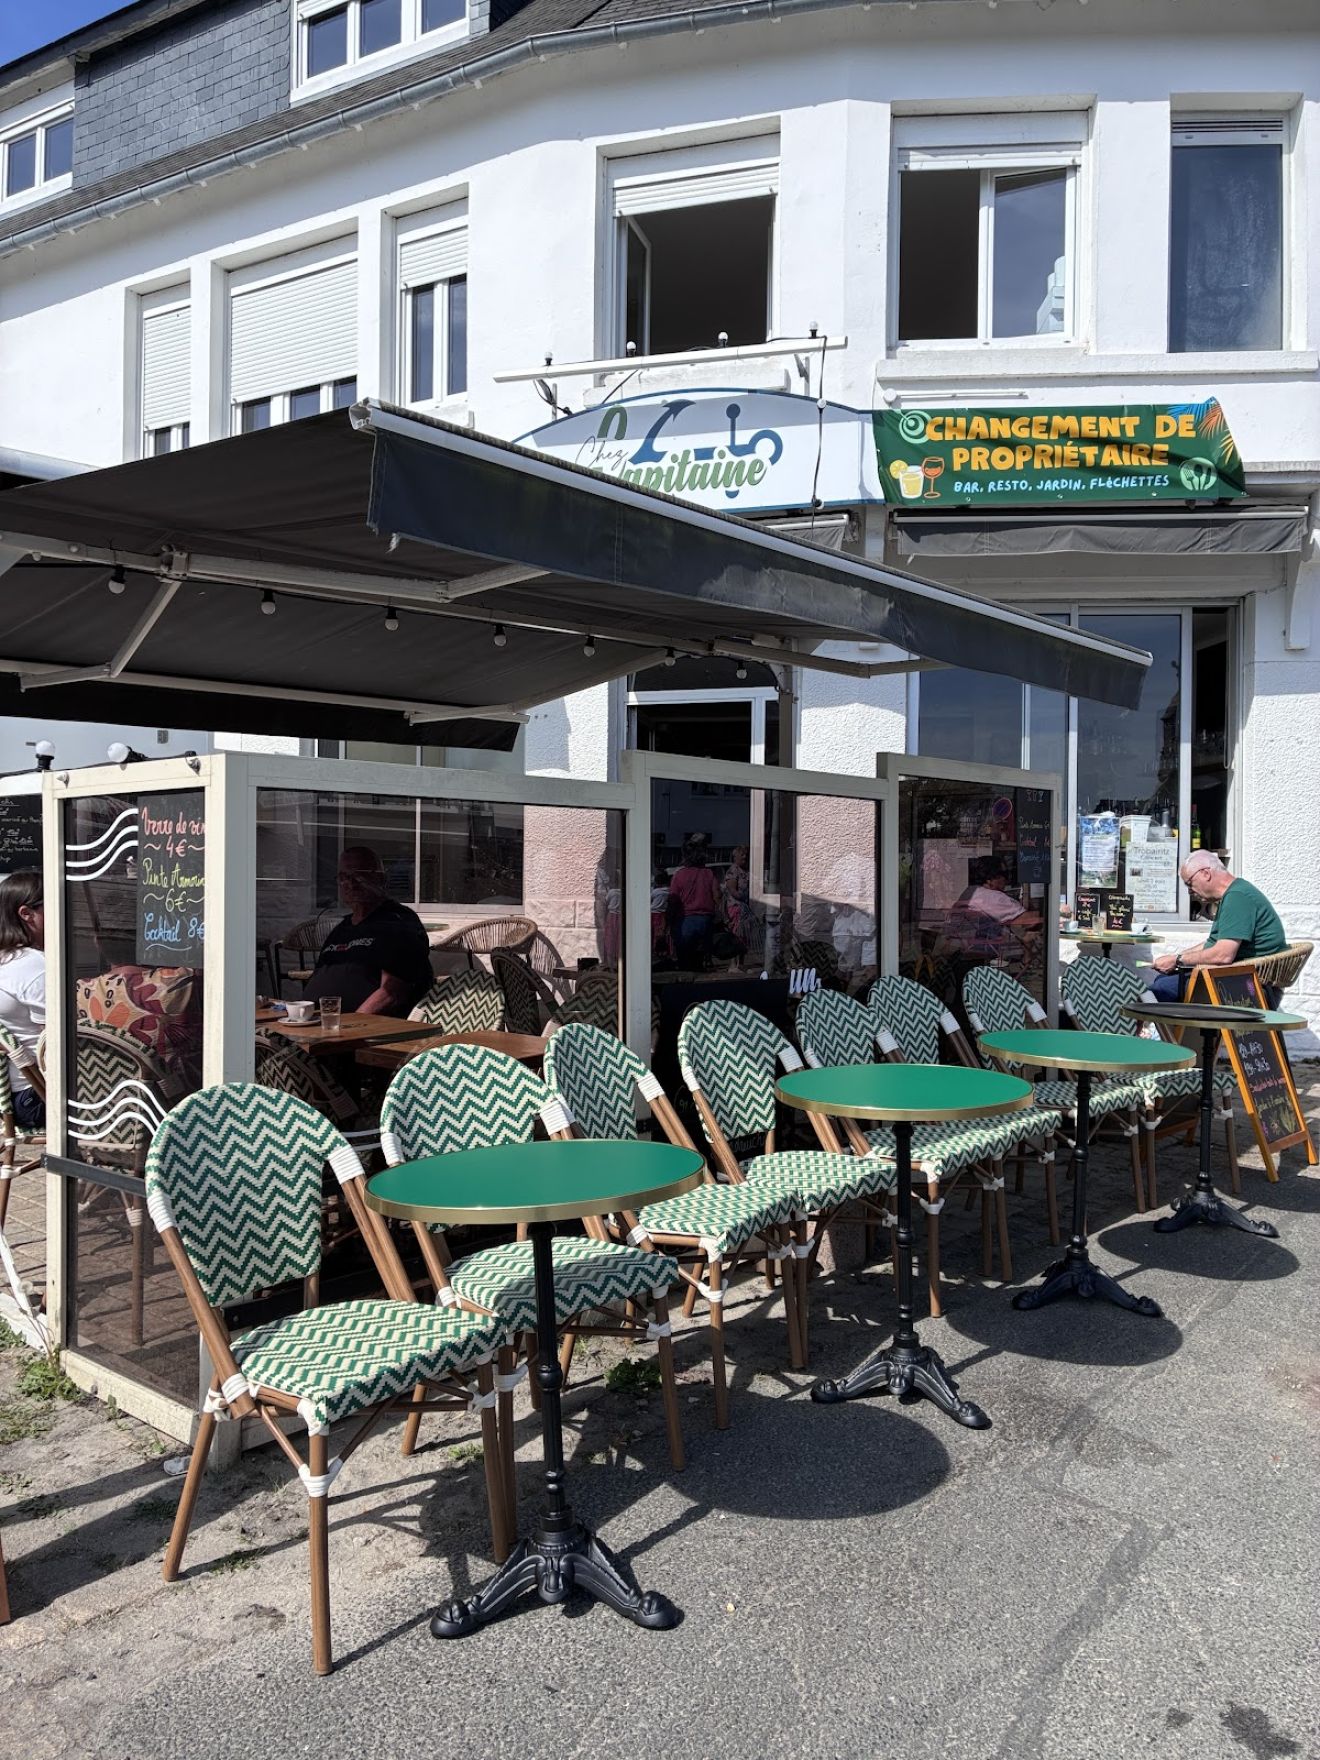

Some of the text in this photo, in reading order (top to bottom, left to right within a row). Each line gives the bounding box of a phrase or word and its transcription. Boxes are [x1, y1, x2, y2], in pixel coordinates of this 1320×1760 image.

[925, 414, 1197, 441] CHANGEMENT DE
[575, 435, 630, 471] Chez
[952, 441, 1170, 472] PROPRIÉTAIRE
[953, 480, 984, 494] BAR,
[988, 479, 1033, 493] RESTO,
[1036, 478, 1086, 492] JARDIN,
[141, 806, 173, 836] Verre
[176, 811, 187, 835] de
[165, 836, 187, 858] 4€
[142, 857, 169, 888] Pinte
[165, 888, 187, 913] 6€
[144, 912, 205, 942] Cocktail 8€
